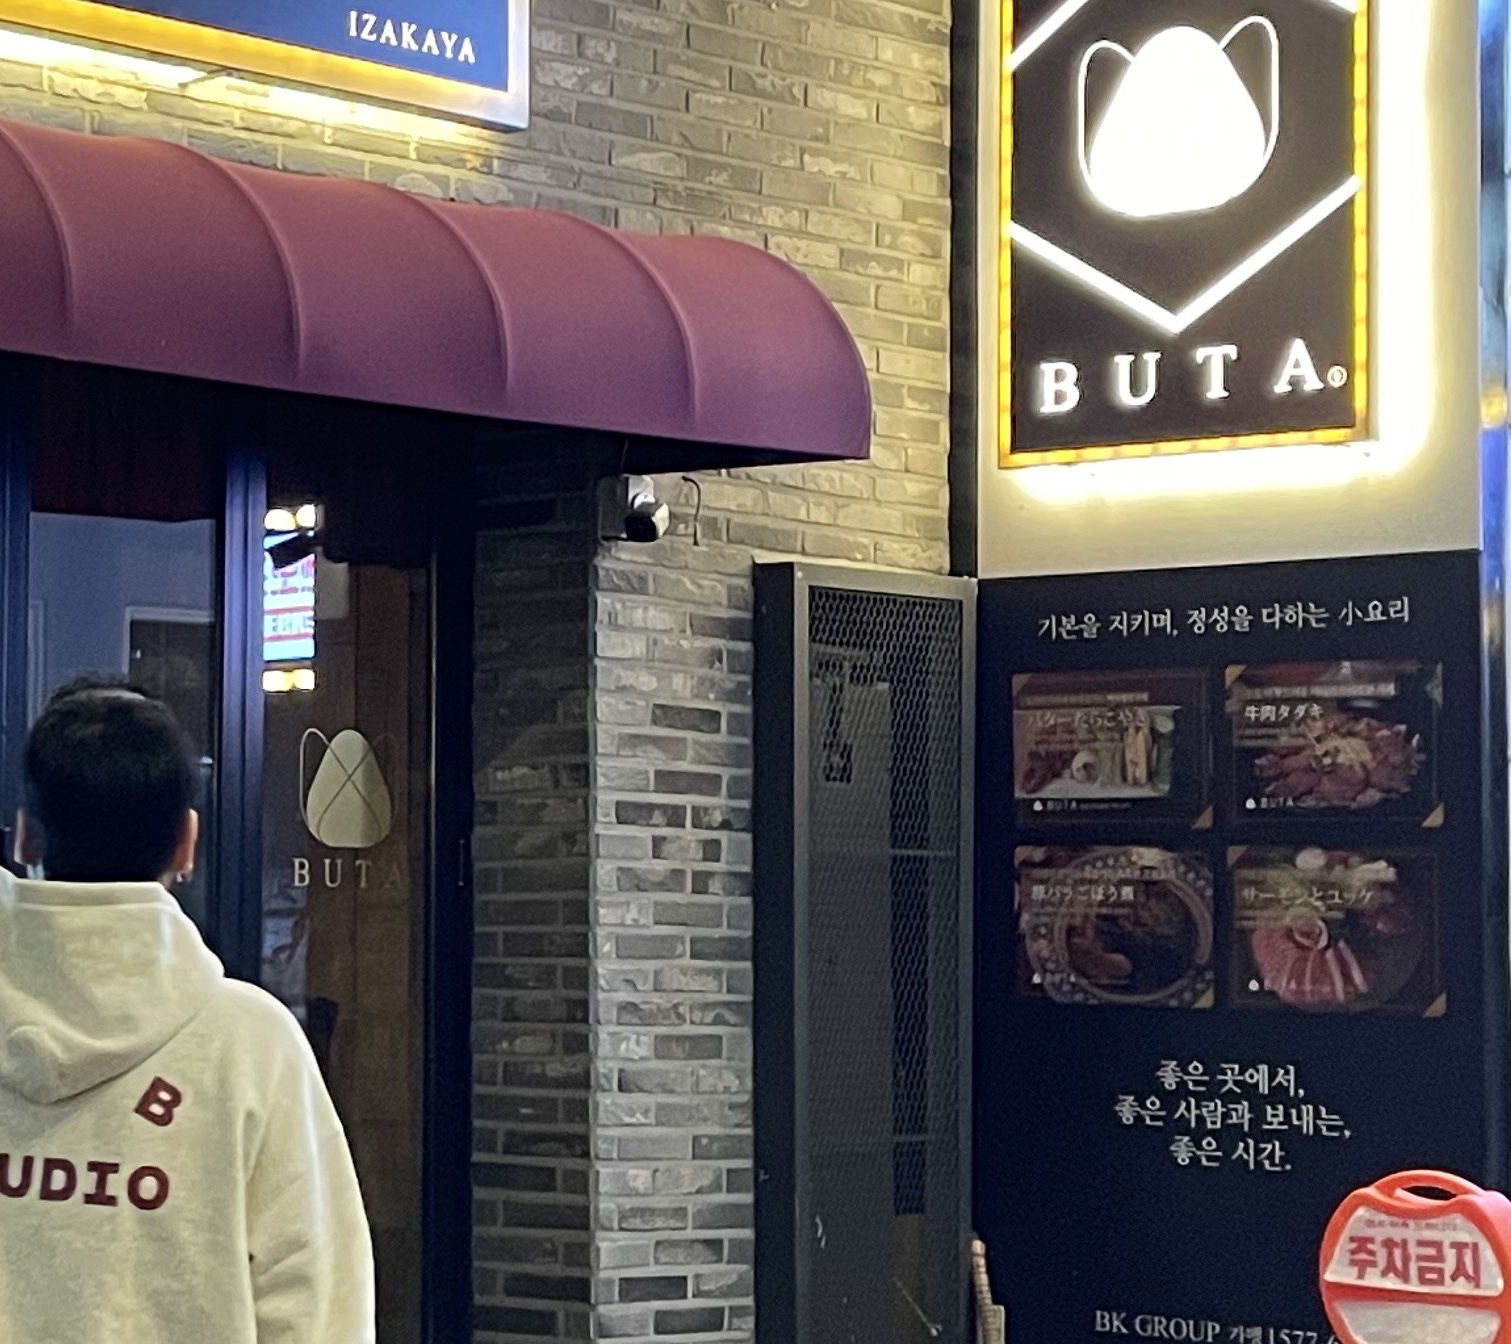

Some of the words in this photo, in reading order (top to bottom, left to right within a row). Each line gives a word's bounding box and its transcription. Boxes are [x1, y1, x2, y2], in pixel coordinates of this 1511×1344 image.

[347, 10, 478, 65] IZAKAYA
[1037, 337, 1325, 414] BUTA
[1038, 612, 1102, 641] 기본을
[1107, 607, 1179, 638] 지키며,
[1186, 604, 1254, 635] 정성을
[1261, 601, 1330, 631] 다하는
[1337, 596, 1410, 627] 小요리
[133, 1075, 183, 1127] B
[1155, 1059, 1210, 1093] 좋은
[1216, 1062, 1306, 1099] 곳에서,
[1113, 1094, 1168, 1128] 좋은
[1173, 1097, 1254, 1132] 사람과
[1262, 1103, 1352, 1140] 보내는,
[1169, 1134, 1224, 1167] 좋은
[1231, 1138, 1292, 1172] 시간.
[1348, 1235, 1482, 1290] 주차금지
[1094, 1309, 1129, 1335] BK
[1134, 1313, 1221, 1344] GROUP
